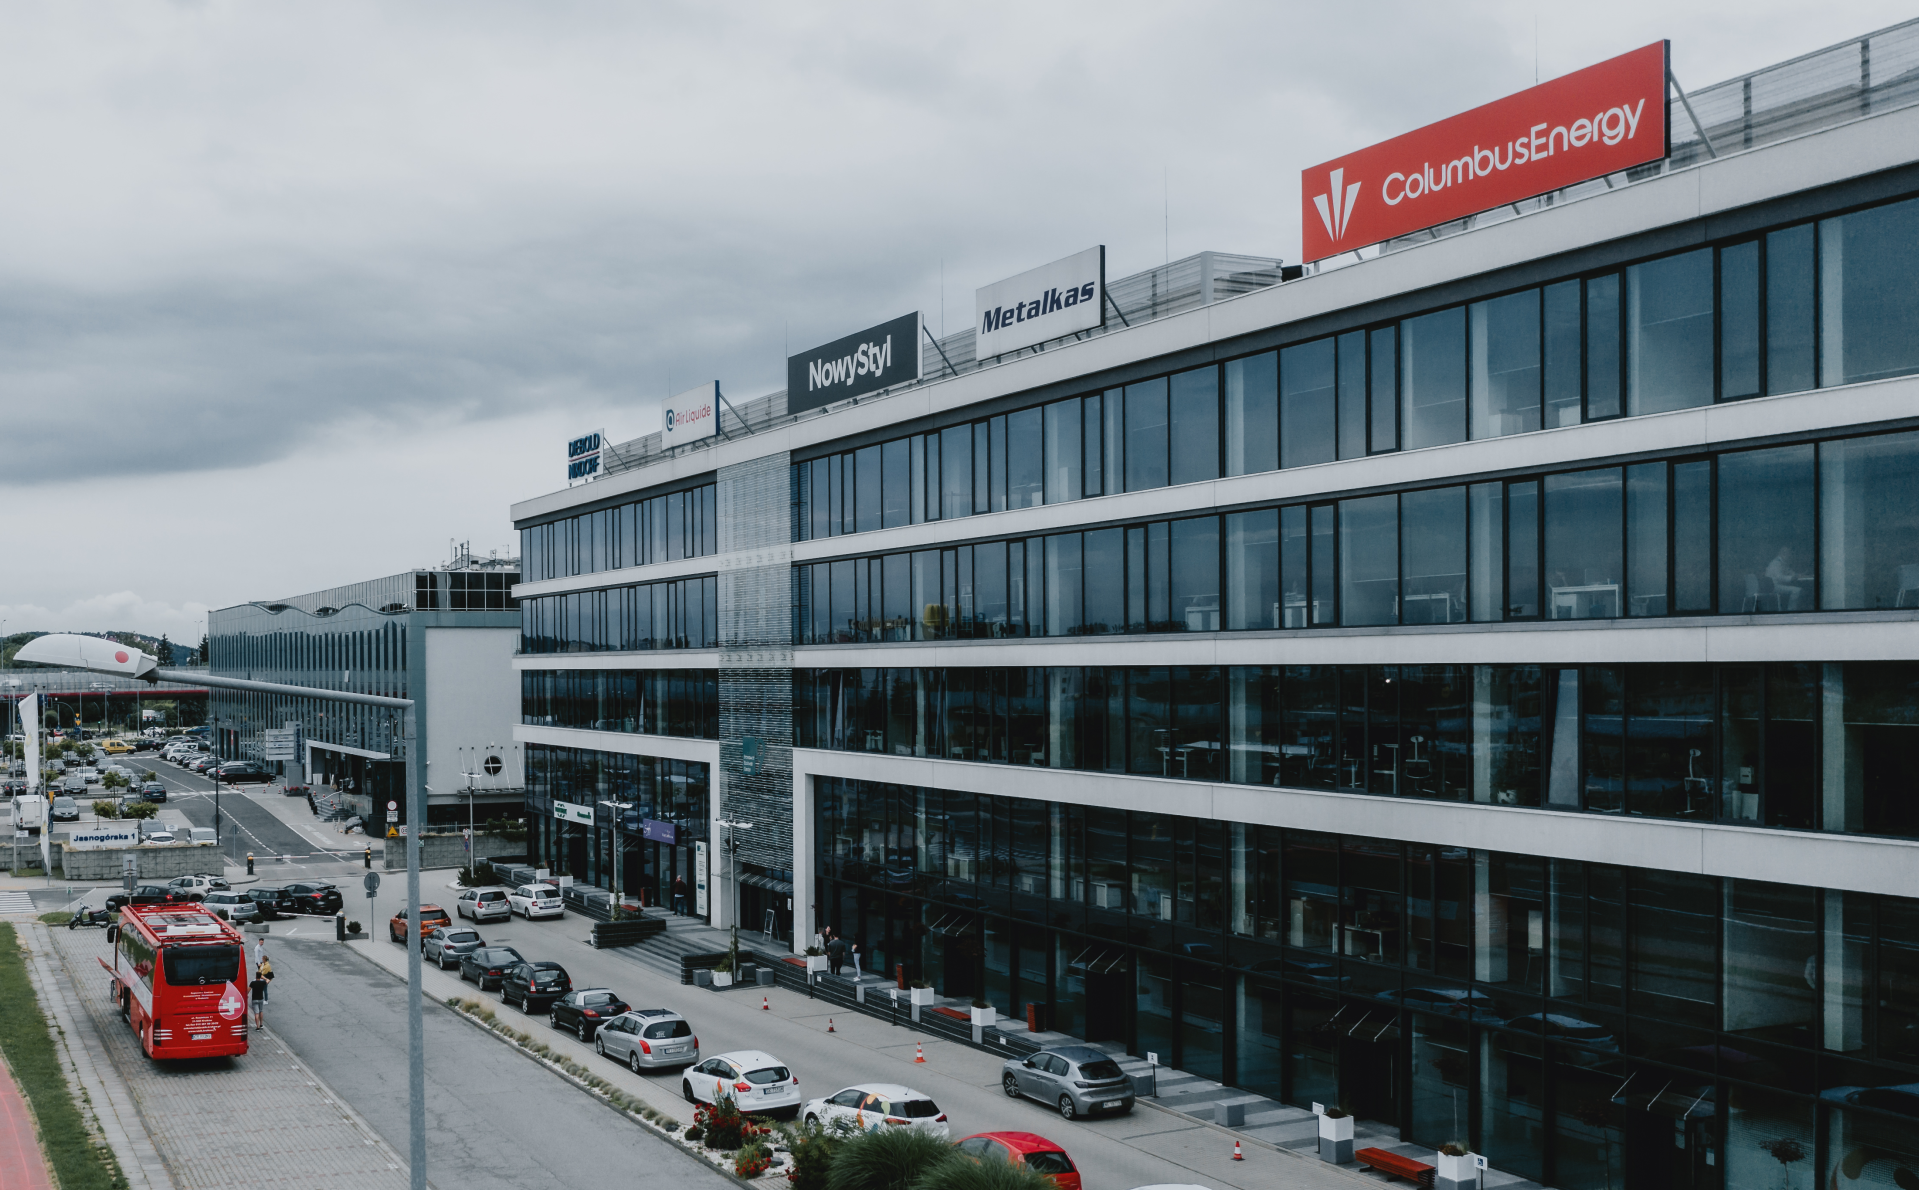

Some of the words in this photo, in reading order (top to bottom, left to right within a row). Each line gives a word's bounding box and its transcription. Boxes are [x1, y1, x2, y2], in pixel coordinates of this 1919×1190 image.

[1382, 98, 1646, 206] ColumbusEnergy
[982, 281, 1095, 335] Metalkas
[809, 334, 891, 392] NowyStyl
[675, 412, 685, 427] Air
[686, 403, 711, 425] Liquide
[568, 433, 600, 458] DIEBOLD
[568, 455, 600, 480] NIXDORF
[73, 833, 129, 842] Jasnogórska
[131, 832, 135, 840] 1
